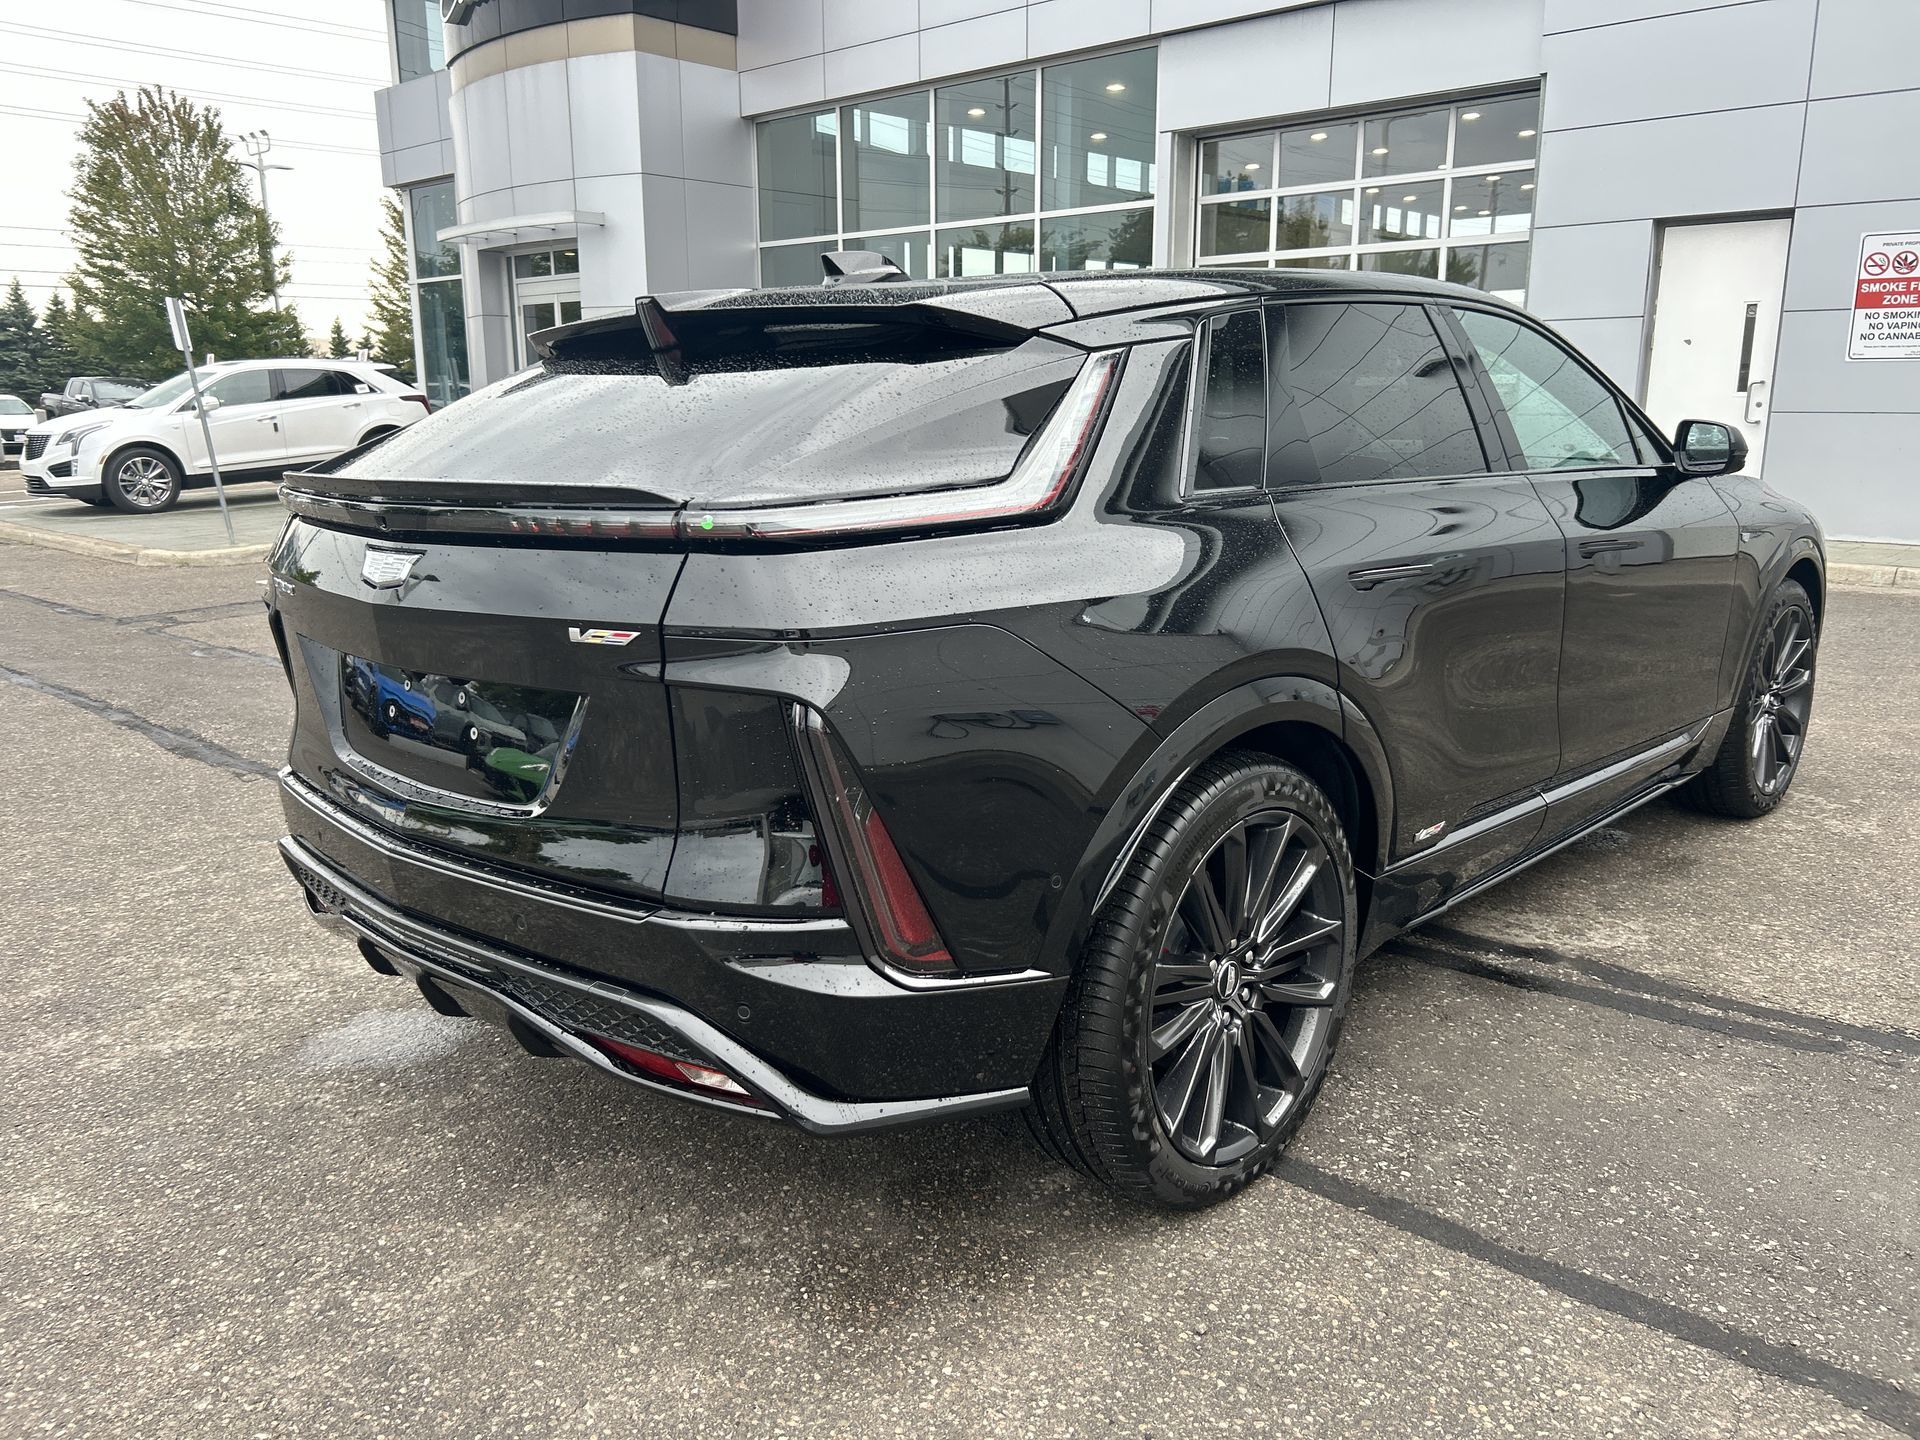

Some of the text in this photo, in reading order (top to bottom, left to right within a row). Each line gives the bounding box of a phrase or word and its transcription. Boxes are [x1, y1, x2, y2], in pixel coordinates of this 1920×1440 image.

[1861, 281, 1908, 293] SMOKE
[1882, 294, 1919, 305] ZONE
[1864, 312, 1880, 320] NO
[1868, 322, 1884, 330] NO
[1860, 332, 1875, 341] NO
